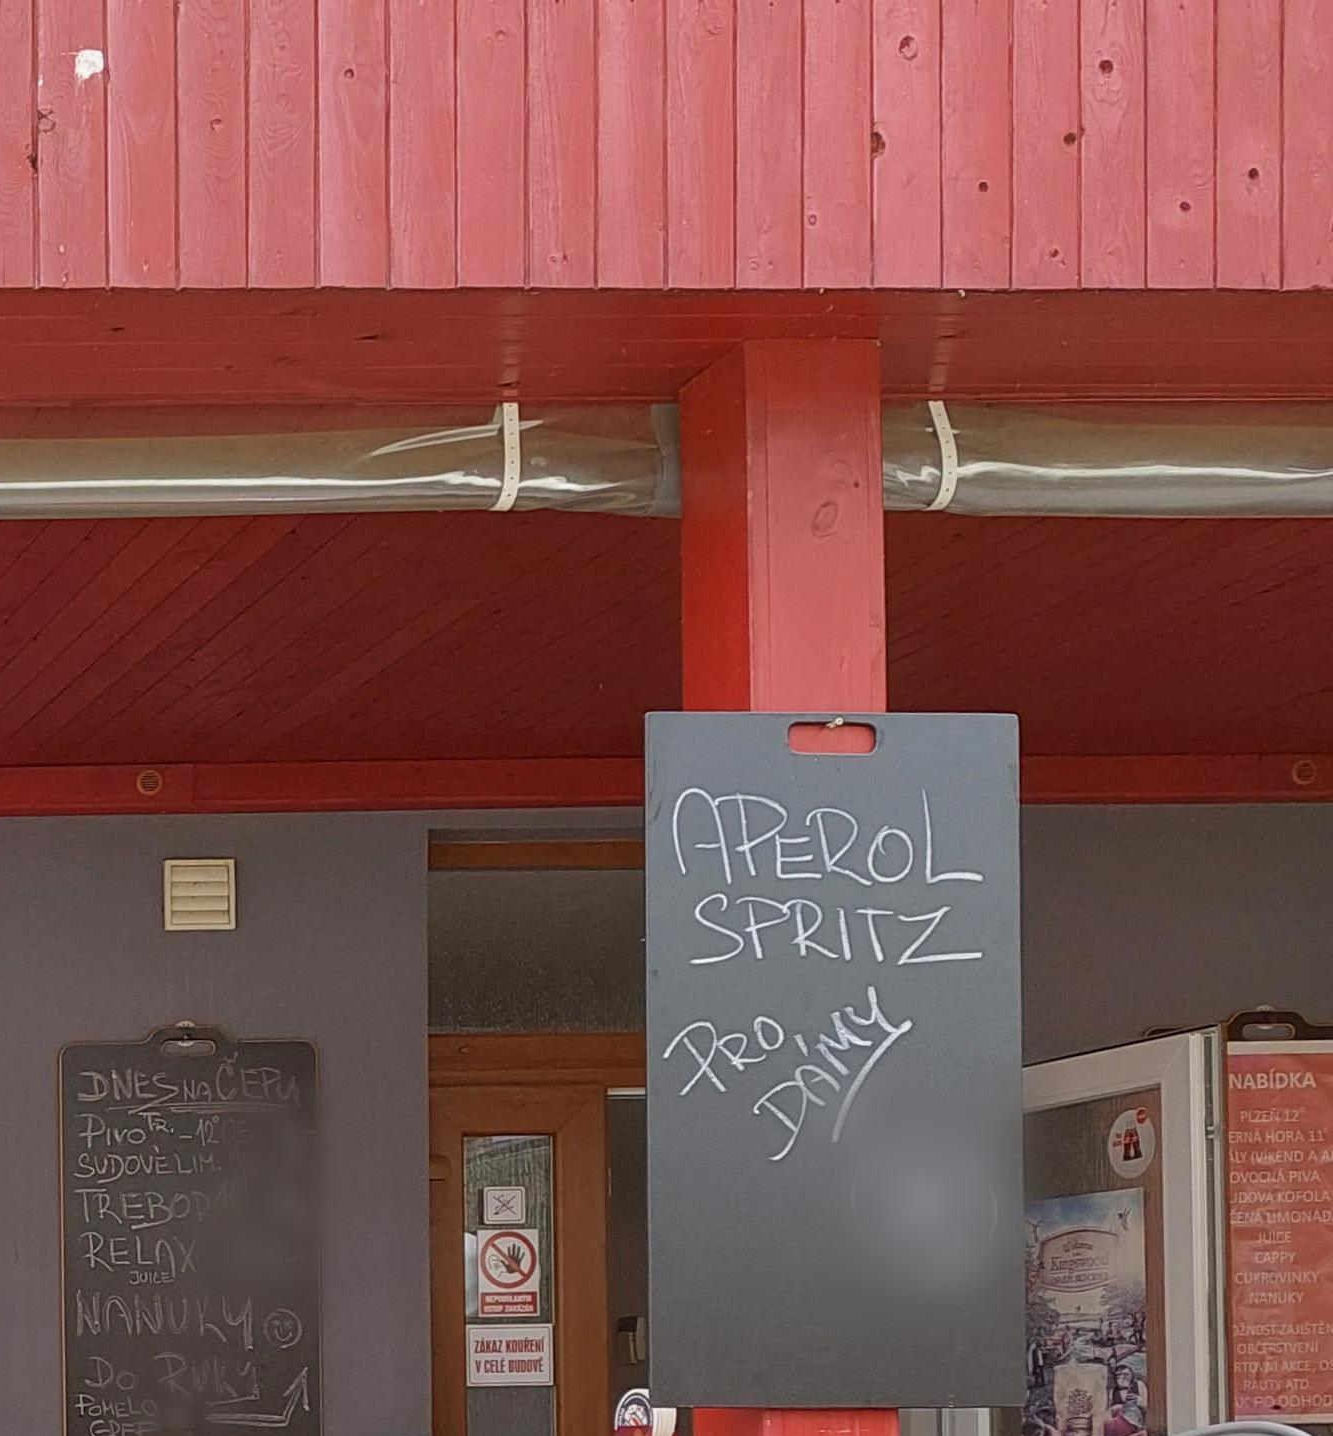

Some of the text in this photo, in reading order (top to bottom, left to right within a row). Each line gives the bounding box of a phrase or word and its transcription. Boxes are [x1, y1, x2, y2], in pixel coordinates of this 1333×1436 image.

[672, 787, 984, 887] APEROL
[690, 892, 984, 966] SPRITZ
[663, 1015, 786, 1096] PRO
[1228, 1068, 1317, 1090] NABÍDKA
[1228, 1128, 1263, 1143] ERNÁ
[1265, 1130, 1305, 1143] HORA
[1288, 1170, 1322, 1183] PIVA
[78, 1230, 198, 1275] RELAX
[1254, 1251, 1297, 1265] CAPPY
[1235, 1271, 1320, 1285] CUKROVINKY
[474, 1337, 502, 1354] ZÁKAZ
